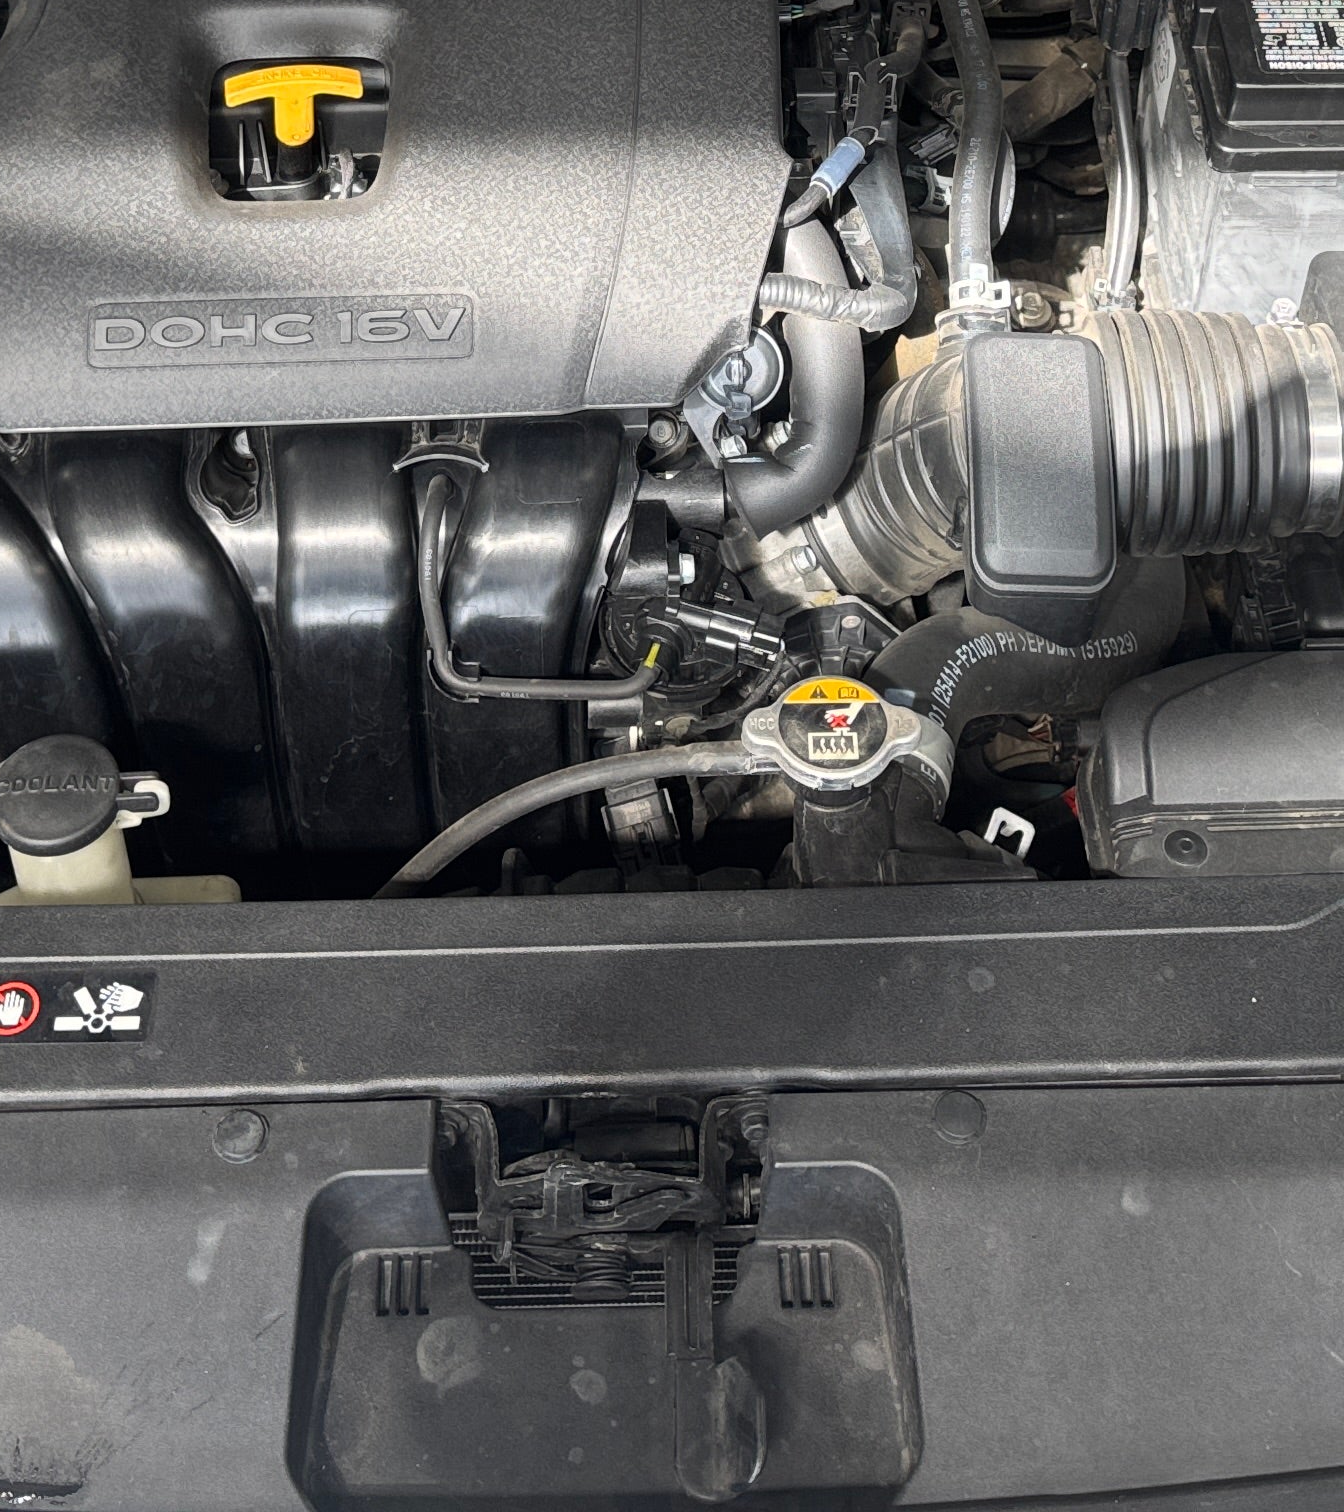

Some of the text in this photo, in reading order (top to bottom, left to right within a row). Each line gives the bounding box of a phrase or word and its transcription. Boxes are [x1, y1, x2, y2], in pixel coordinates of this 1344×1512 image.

[94, 307, 467, 351] DOHC 16V
[997, 632, 1019, 653] PH
[749, 716, 776, 731] HCC
